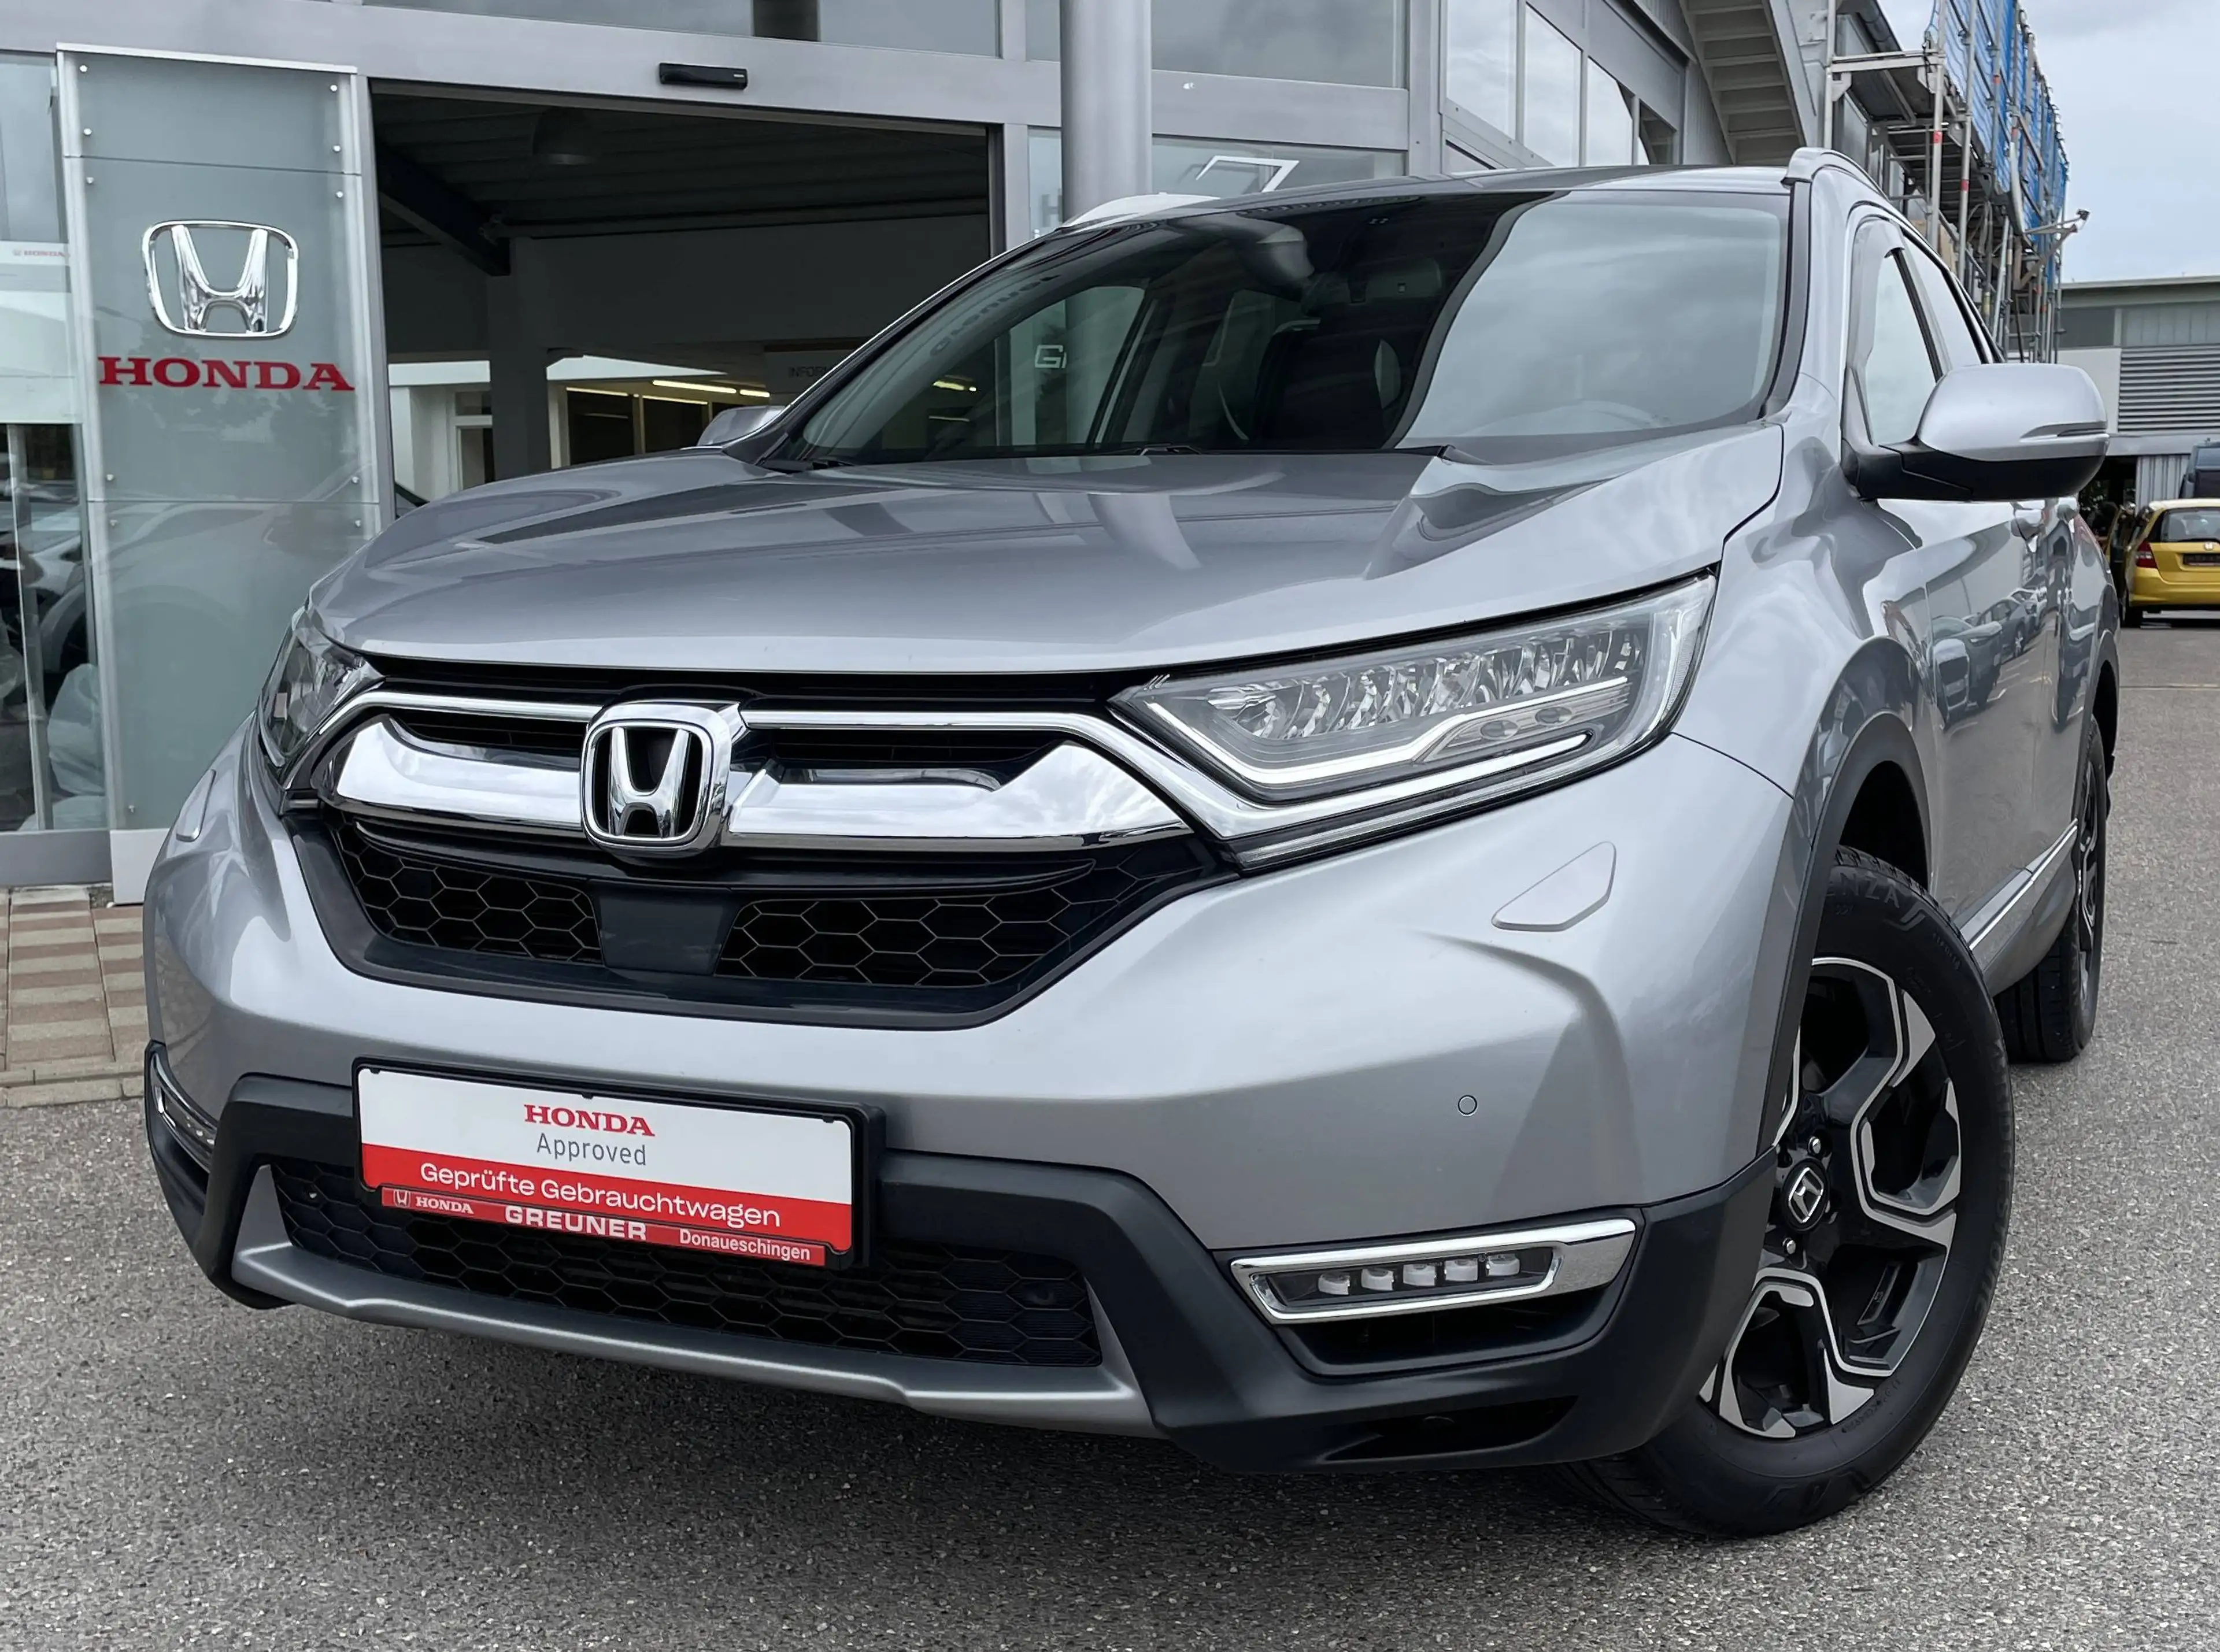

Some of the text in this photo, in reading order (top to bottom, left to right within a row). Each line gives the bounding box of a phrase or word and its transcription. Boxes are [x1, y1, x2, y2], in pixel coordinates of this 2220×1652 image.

[98, 357, 355, 391] HONDA
[524, 1103, 655, 1136] HONDA
[536, 1132, 646, 1165] Approved
[420, 1162, 781, 1229] Geprüfte Gebrauchtwagen
[415, 1196, 811, 1262] HONDA GREUNER Donaueschingen
